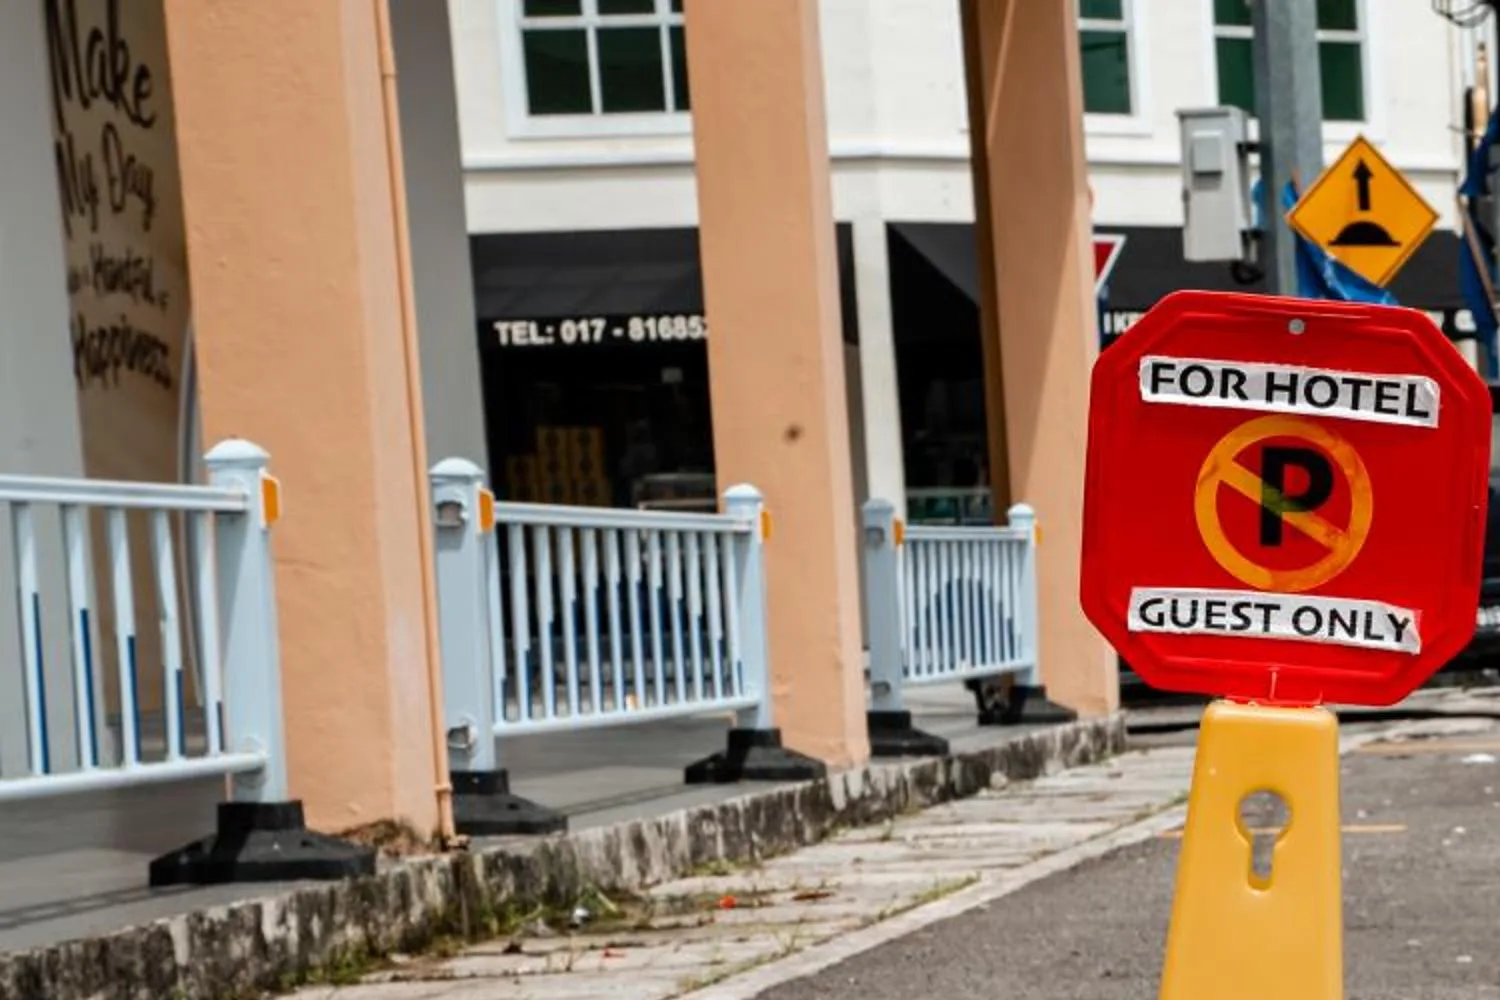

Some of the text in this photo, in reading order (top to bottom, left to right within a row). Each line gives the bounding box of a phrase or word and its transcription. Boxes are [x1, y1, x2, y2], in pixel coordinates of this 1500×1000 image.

[103, 121, 156, 232] Day
[494, 320, 555, 346] TEL:
[559, 317, 607, 344] 017
[1150, 362, 1431, 418] FOR HOTEL
[1258, 446, 1334, 548] P
[1138, 598, 1412, 643] GUEST ONLY
